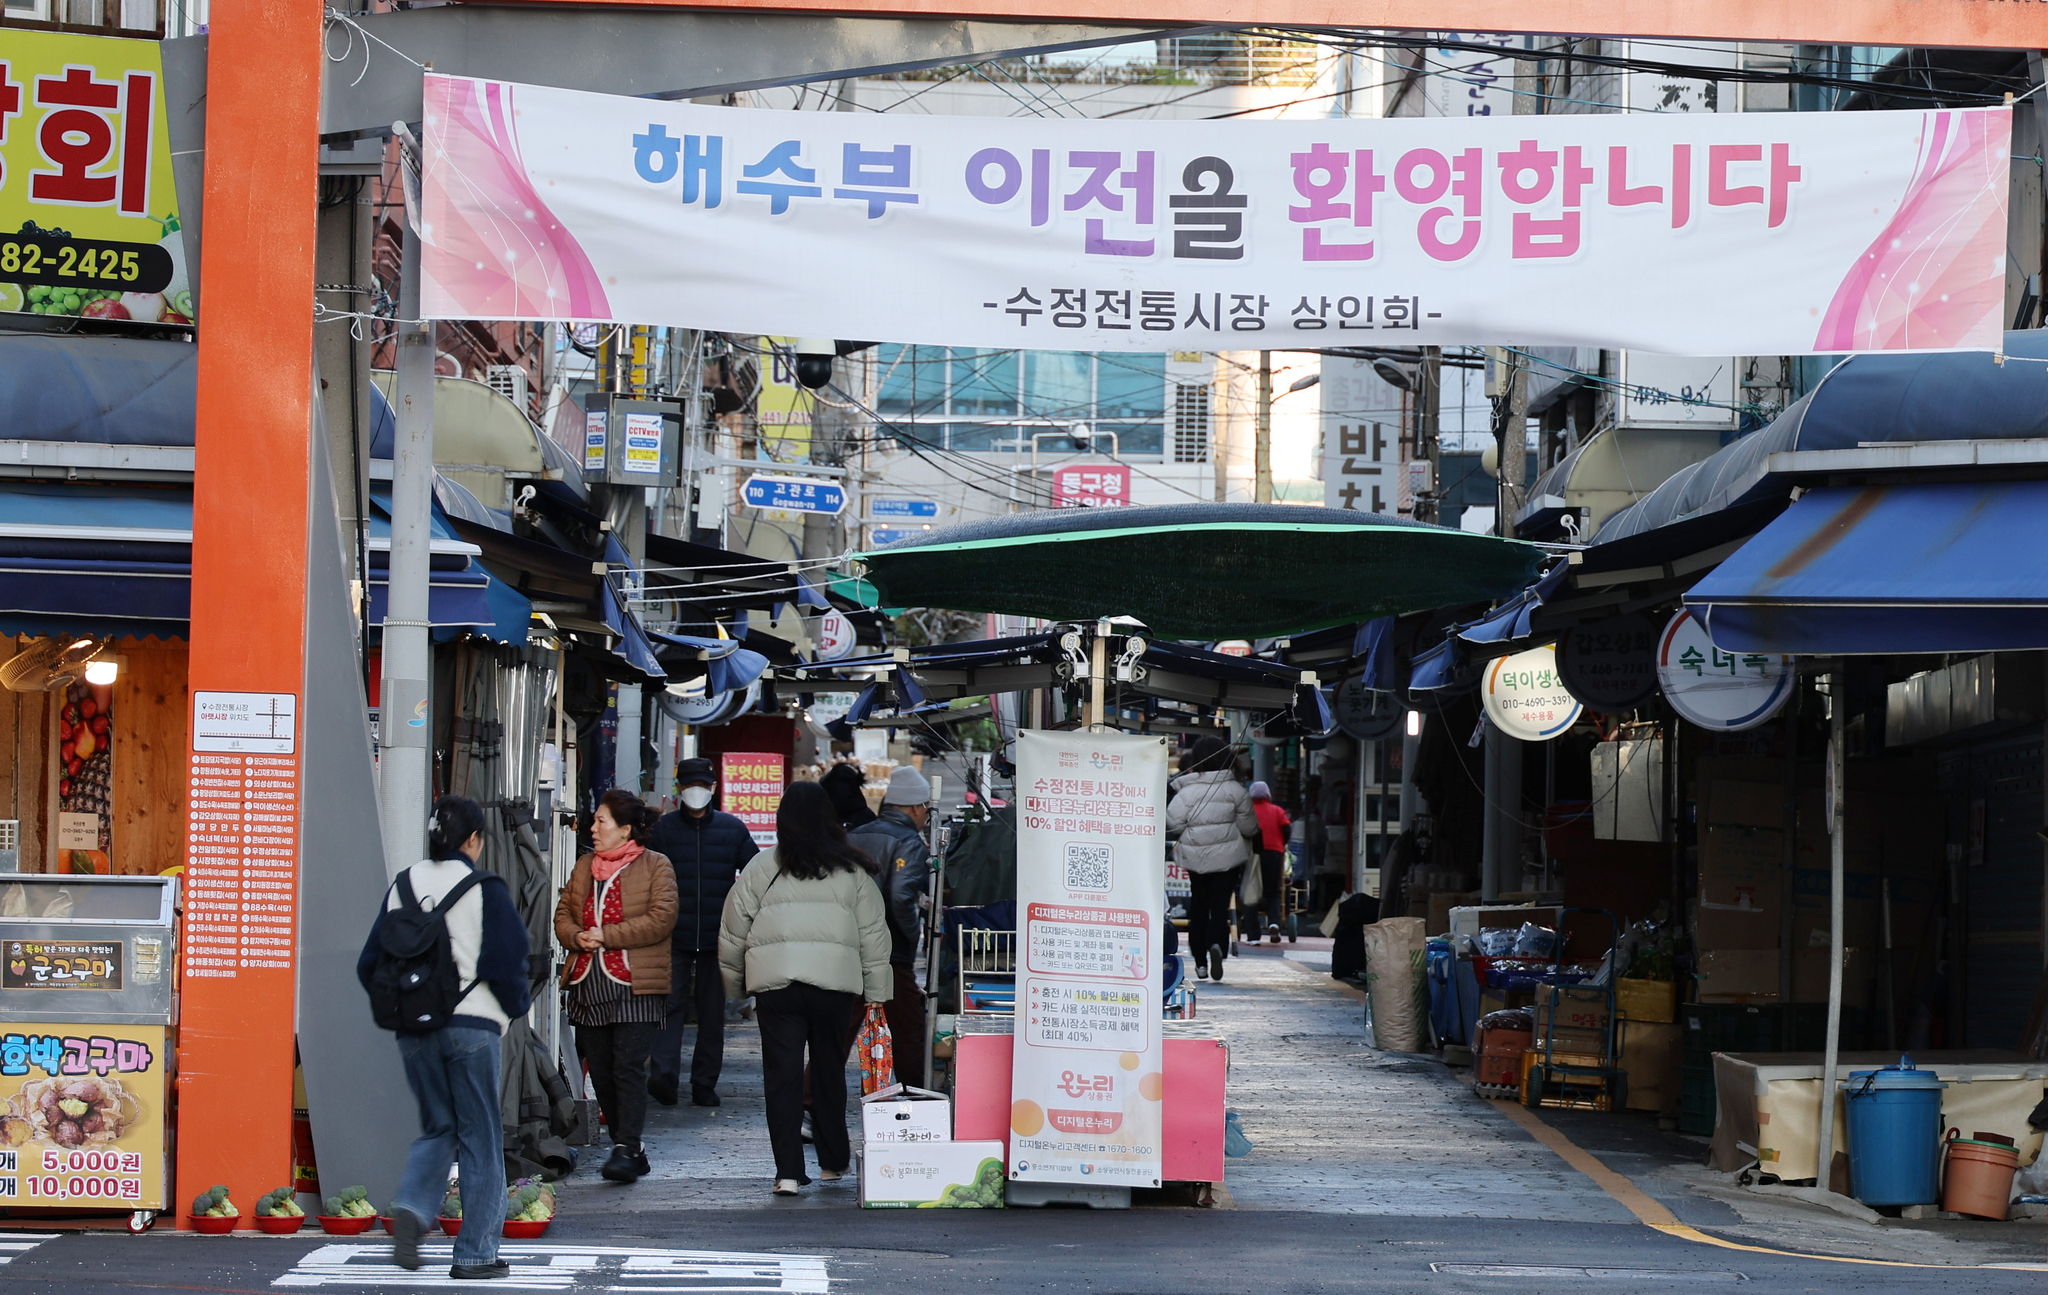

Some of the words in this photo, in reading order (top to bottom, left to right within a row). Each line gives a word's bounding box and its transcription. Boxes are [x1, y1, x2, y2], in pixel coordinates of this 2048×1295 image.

[0, 60, 156, 215] 회
[633, 123, 919, 219] 해수부
[965, 148, 1247, 260] 이전을
[1288, 140, 1801, 262] 환영합니다
[1061, 472, 1122, 495] 동구청
[749, 487, 764, 498] 110
[774, 484, 816, 498] 고관로
[825, 494, 839, 505] 114
[772, 497, 815, 510] Gogwan-ro
[1576, 632, 1650, 654] 갑오상회
[1503, 695, 1571, 709] 010-4690-3391
[1522, 711, 1554, 721] 제수용품
[1089, 752, 1124, 769] 온누리
[724, 765, 782, 781] 무엇이든
[1034, 778, 1146, 798] 수정전통시장에서
[253, 803, 294, 811] 덕이생선(수산)
[723, 796, 780, 811] 무엇이든
[1026, 796, 1154, 818] 디지털온누리상품권으로
[1025, 816, 1051, 831] 10%
[1054, 818, 1076, 832] 할인
[1079, 820, 1112, 834] 혜택을
[1114, 823, 1156, 836] 받으세요!
[1084, 894, 1108, 902] 다운로드
[251, 904, 291, 912] 88수육(식당)
[1035, 907, 1107, 921] 디지털온누리상품권
[1109, 912, 1141, 924] 사용방법
[1041, 926, 1102, 938] 디지털온누리상품권
[1112, 930, 1139, 940] 다운로드
[26, 945, 42, 954] 특허
[58, 946, 76, 954] 기계로
[1041, 937, 1055, 947] 사용
[1057, 938, 1072, 948] 카드
[1073, 939, 1081, 949] 및
[1082, 940, 1097, 949] 계좌
[1099, 941, 1114, 950] 등록
[1041, 949, 1055, 958] 사용
[1057, 950, 1072, 960] 금액
[1073, 951, 1088, 961] 충전
[1090, 952, 1097, 961] 후
[1099, 953, 1114, 962] 결제
[31, 956, 115, 982] 군고구마
[1047, 961, 1059, 969] 카드
[1061, 961, 1073, 969] 또는
[1075, 962, 1098, 971] QR코드
[1100, 963, 1113, 971] 결제
[1042, 987, 1060, 998] 충전
[1063, 989, 1072, 999] 시
[1076, 989, 1096, 1001] 10%
[1100, 990, 1119, 1001] 할인
[1122, 992, 1140, 1002] 혜택
[1042, 1002, 1058, 1012] 카드
[1061, 1004, 1078, 1014] 사용
[1081, 1005, 1120, 1017] 실적(적립)
[1123, 1007, 1139, 1018] 반영
[1042, 1017, 1117, 1031] 전통시장소득공제
[1121, 1022, 1140, 1032] 혜택
[1042, 1031, 1064, 1041] (최대
[1067, 1032, 1093, 1042] 40%)
[0, 1034, 152, 1076] 호박고구마
[1057, 1070, 1114, 1098] 온누리
[1088, 1092, 1113, 1101] 상품권
[1057, 1116, 1113, 1128] 디지털온누리
[1019, 1139, 1096, 1153] 디지털온누리고객센터
[1107, 1145, 1152, 1155] 1670-1600
[43, 1151, 140, 1173] 5,000원
[898, 1167, 939, 1179] 봉화브로콜리
[27, 1177, 140, 1199] 10,000원
